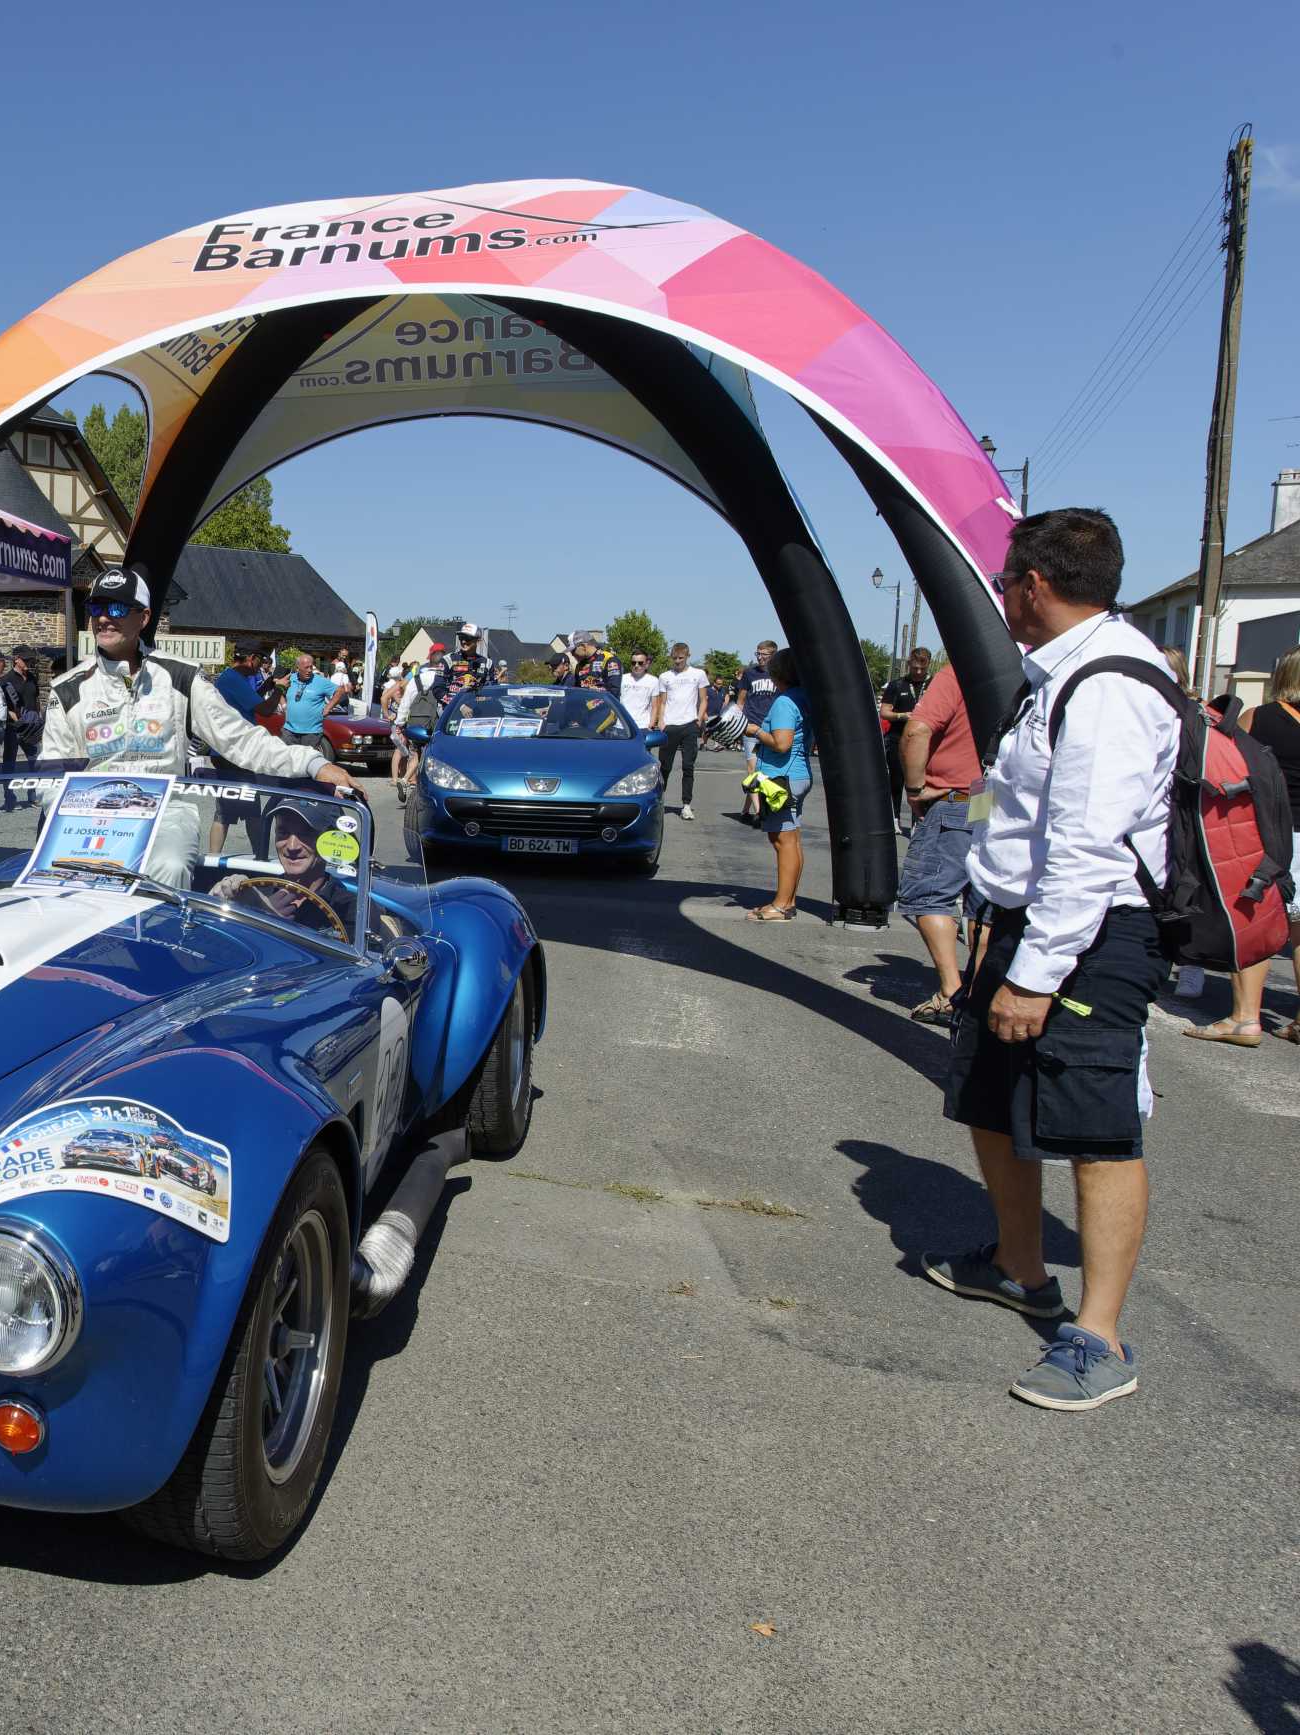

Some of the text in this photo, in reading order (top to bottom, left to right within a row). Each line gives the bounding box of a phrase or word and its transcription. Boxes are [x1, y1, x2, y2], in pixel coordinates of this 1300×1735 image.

[204, 211, 456, 245] France
[8, 778, 257, 802] COBR RANCE
[63, 827, 73, 836] LE
[75, 828, 109, 837] JOSSEC
